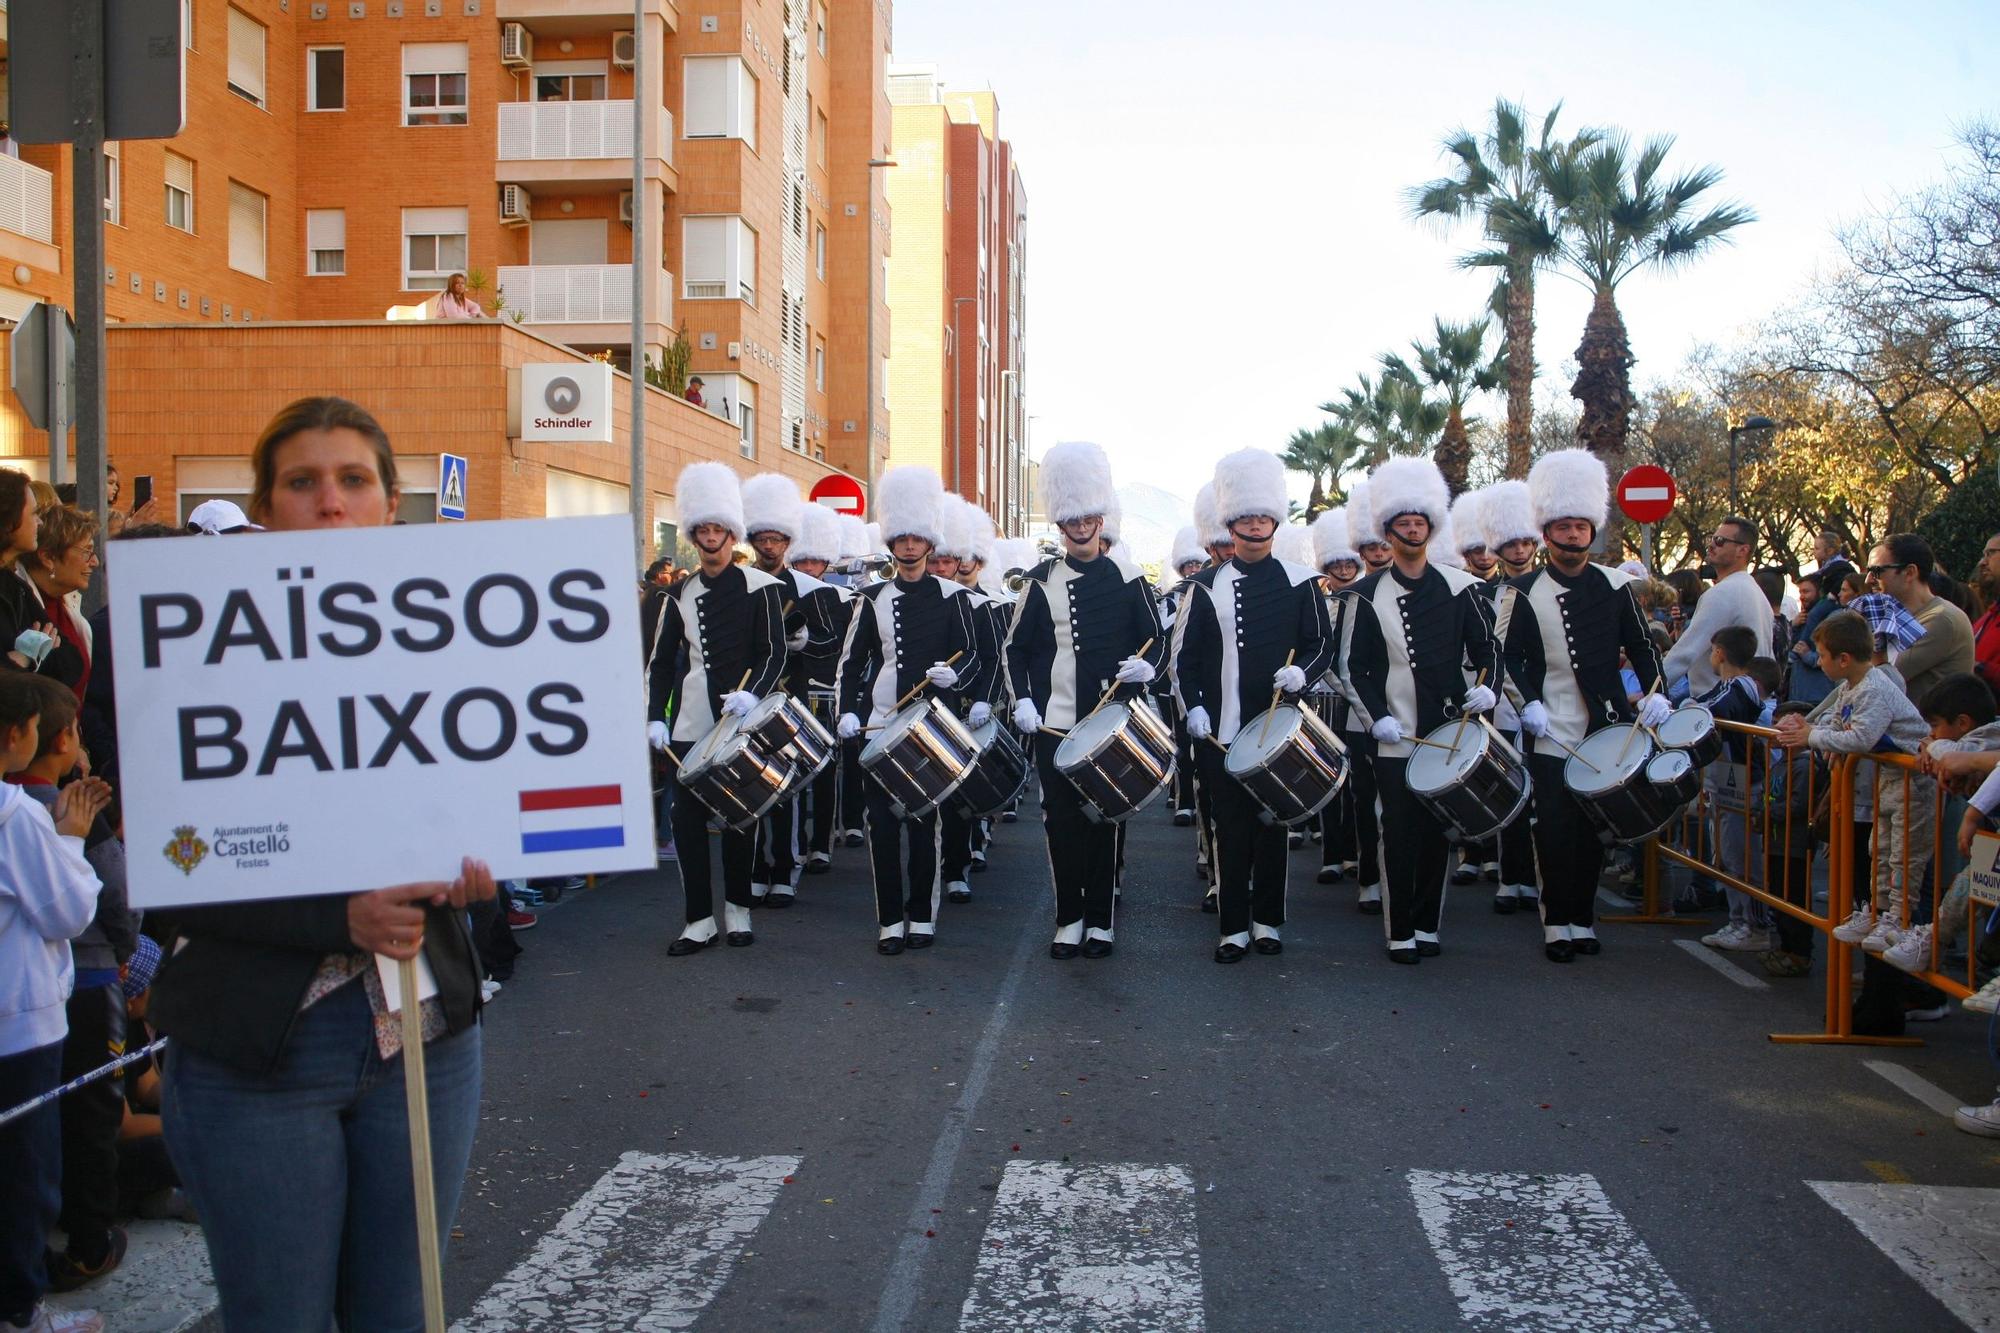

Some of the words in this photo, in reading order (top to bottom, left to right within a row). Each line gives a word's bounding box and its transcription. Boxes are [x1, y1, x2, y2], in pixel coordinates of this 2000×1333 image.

[534, 417, 592, 428] Schindler
[139, 566, 610, 669] PAÏSSOS
[177, 681, 589, 781] BAIXOS
[213, 825, 273, 838] Ajuntament
[275, 822, 289, 832] de
[213, 834, 290, 857] Castelló
[236, 858, 270, 869] Festes
